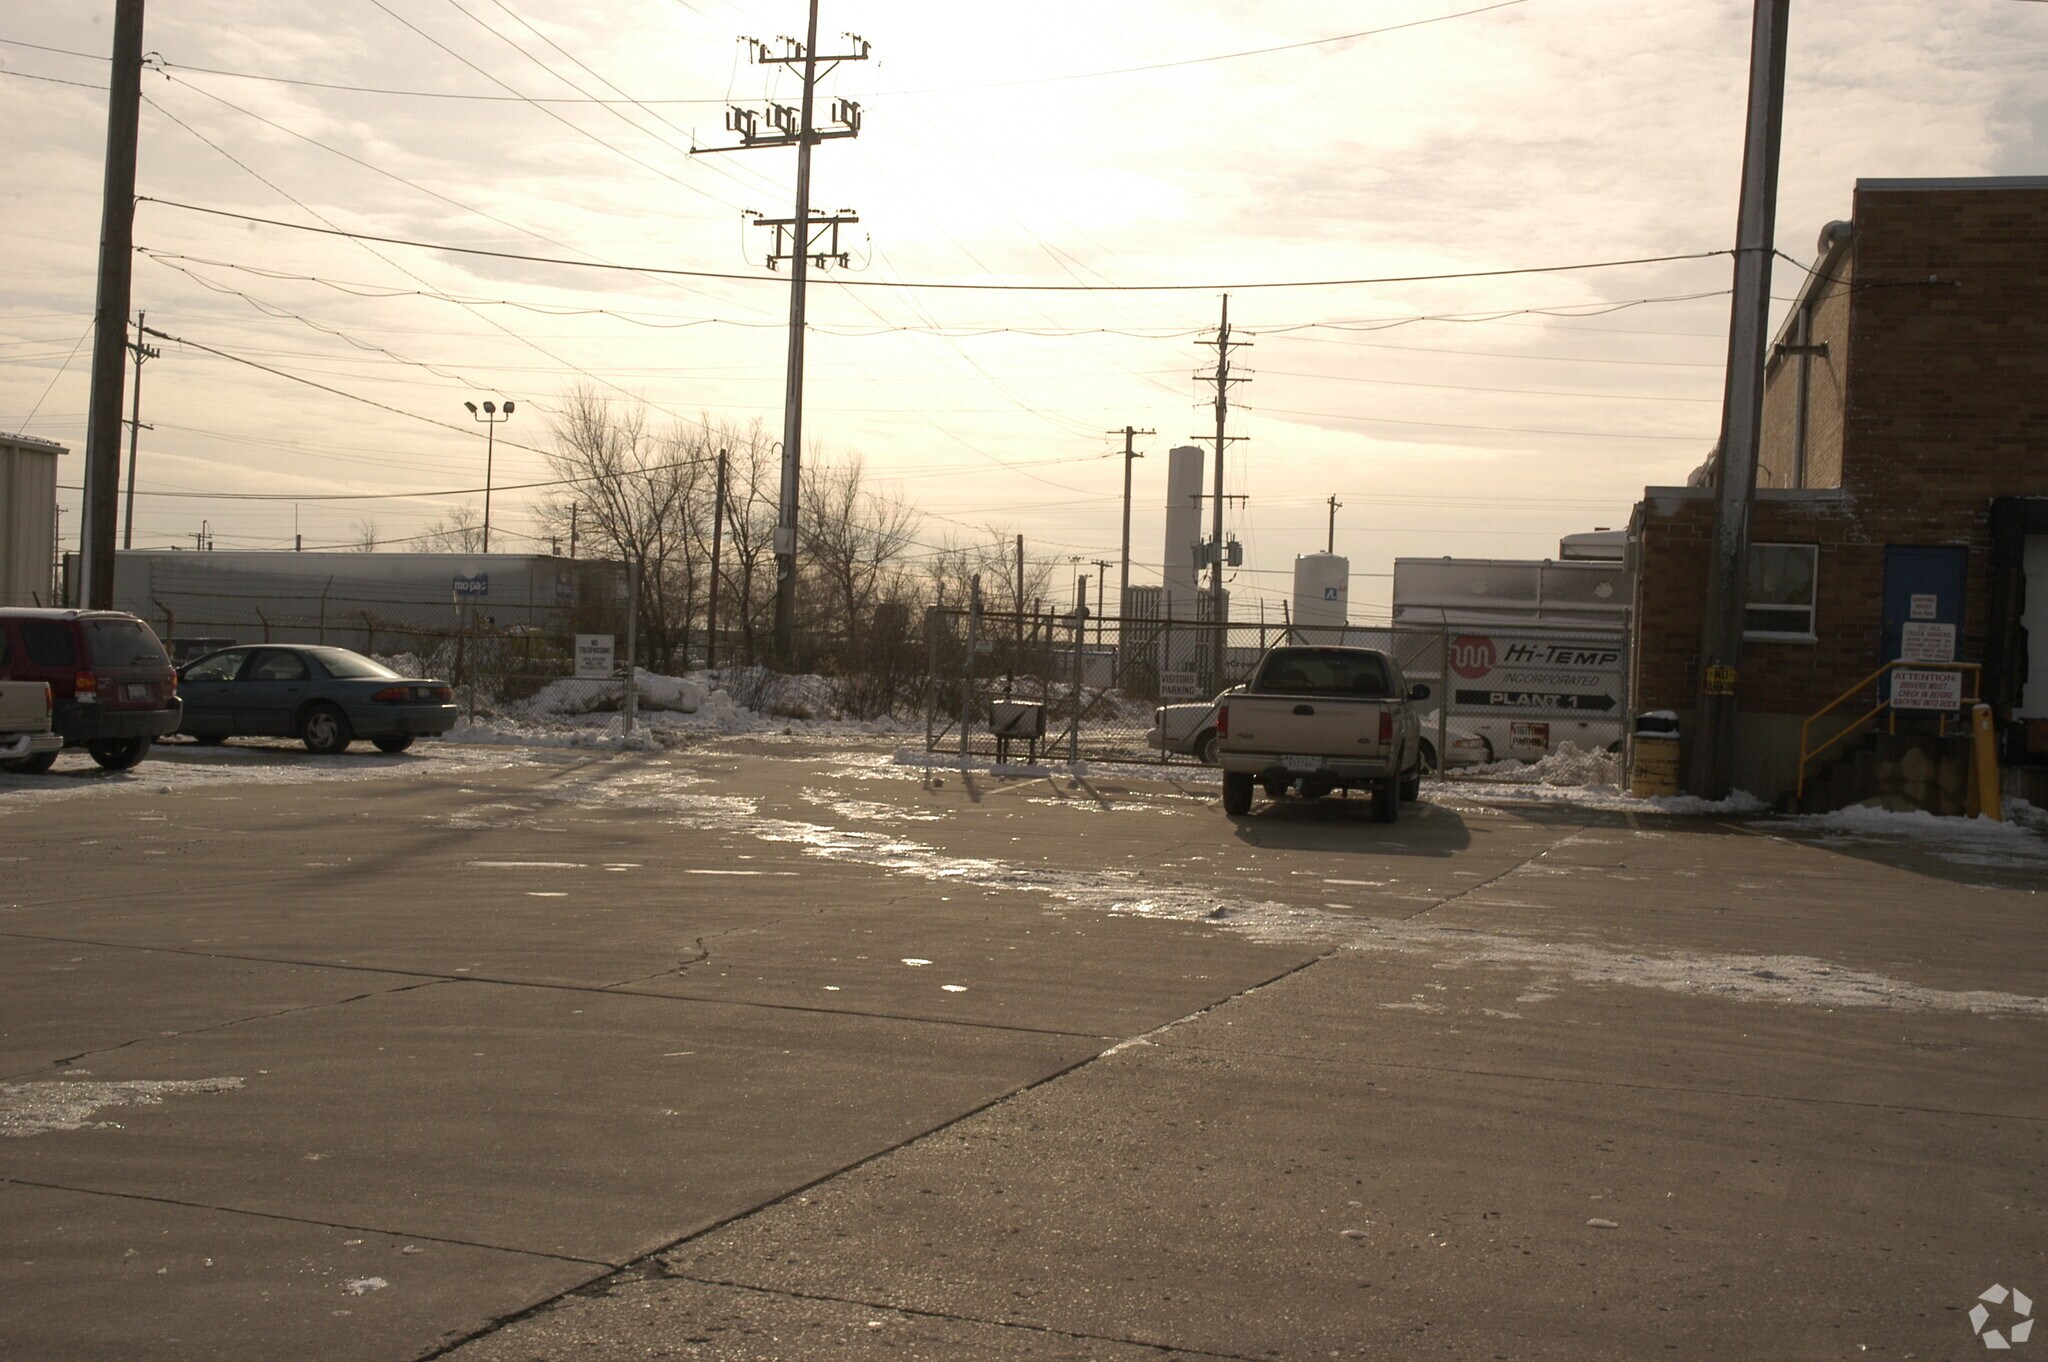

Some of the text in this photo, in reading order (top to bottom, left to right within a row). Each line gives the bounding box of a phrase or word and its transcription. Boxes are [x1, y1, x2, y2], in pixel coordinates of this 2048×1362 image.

[578, 646, 611, 654] TRESPASSING
[1714, 668, 1728, 679] NO
[1161, 674, 1194, 684] VISITORS
[1502, 672, 1600, 687] INCORPORATED
[1161, 685, 1195, 695] PARKING
[1899, 681, 1928, 689] DRIVERS
[1898, 689, 1954, 699] CHECK IN BEFORE
[1489, 691, 1578, 708] PLANT 1
[1893, 698, 1958, 708] BACKING INTO DOCK
